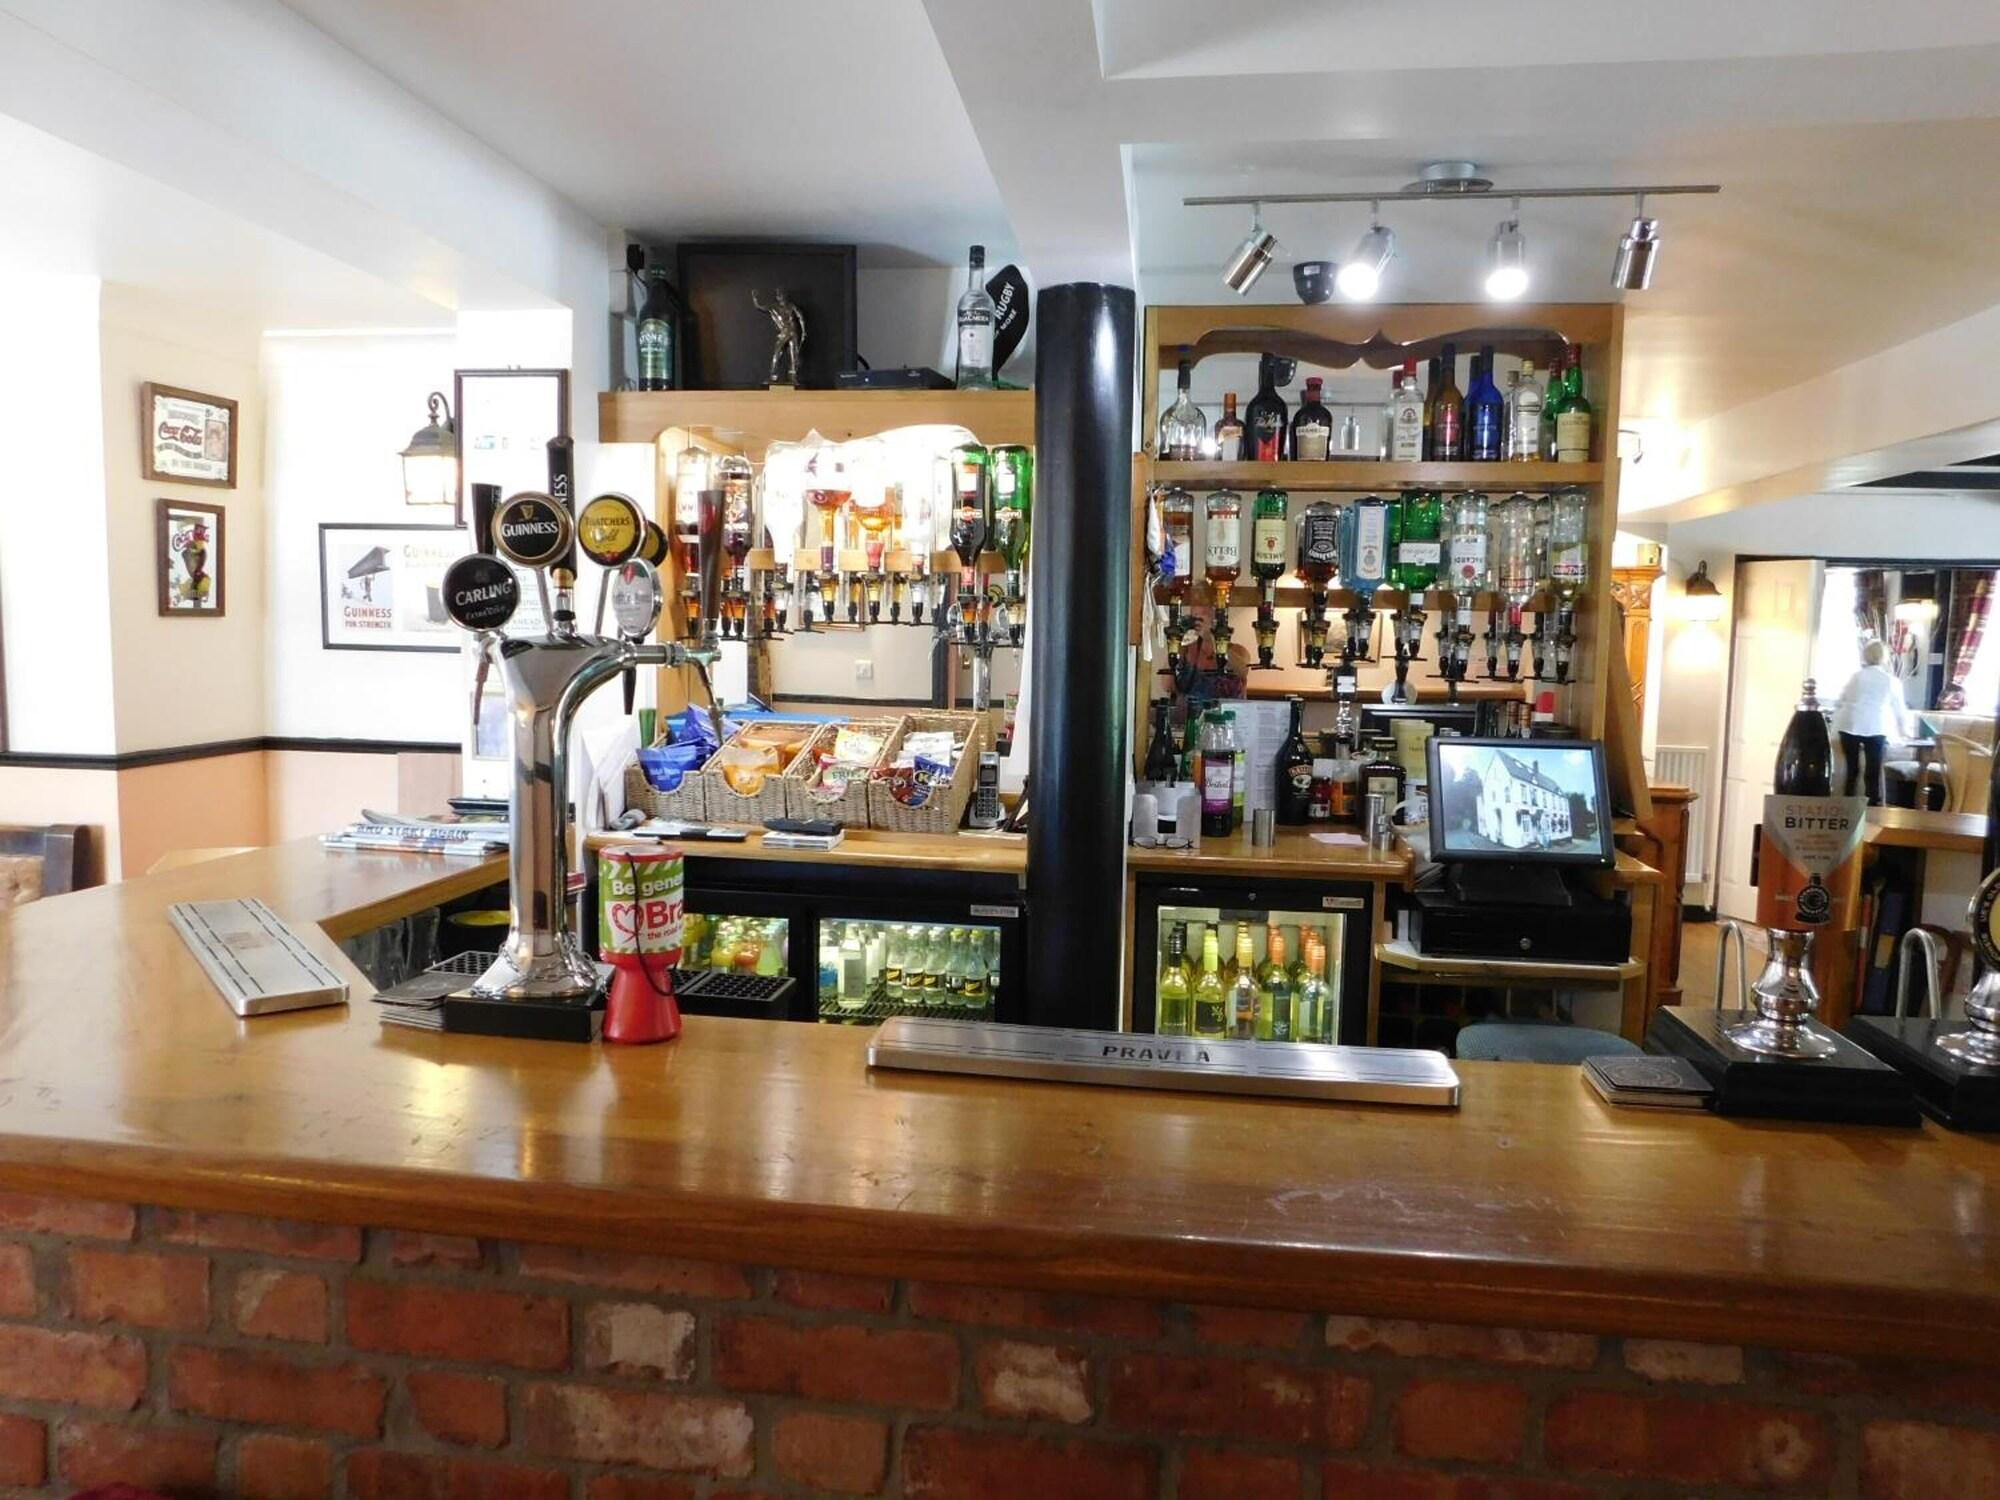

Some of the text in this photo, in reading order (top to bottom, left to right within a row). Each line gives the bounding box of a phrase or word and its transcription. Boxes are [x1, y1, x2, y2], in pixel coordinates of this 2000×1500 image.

[994, 282, 1015, 320] RUGBY
[1000, 309, 1017, 331] MORE
[584, 516, 630, 526] THATCHERS
[502, 522, 558, 537] GUINNESS
[1208, 545, 1237, 557] BELL'S
[456, 581, 512, 606] CARLING
[344, 606, 392, 618] GUINNESS
[1785, 816, 1849, 830] BITTER
[613, 880, 636, 896] Be
